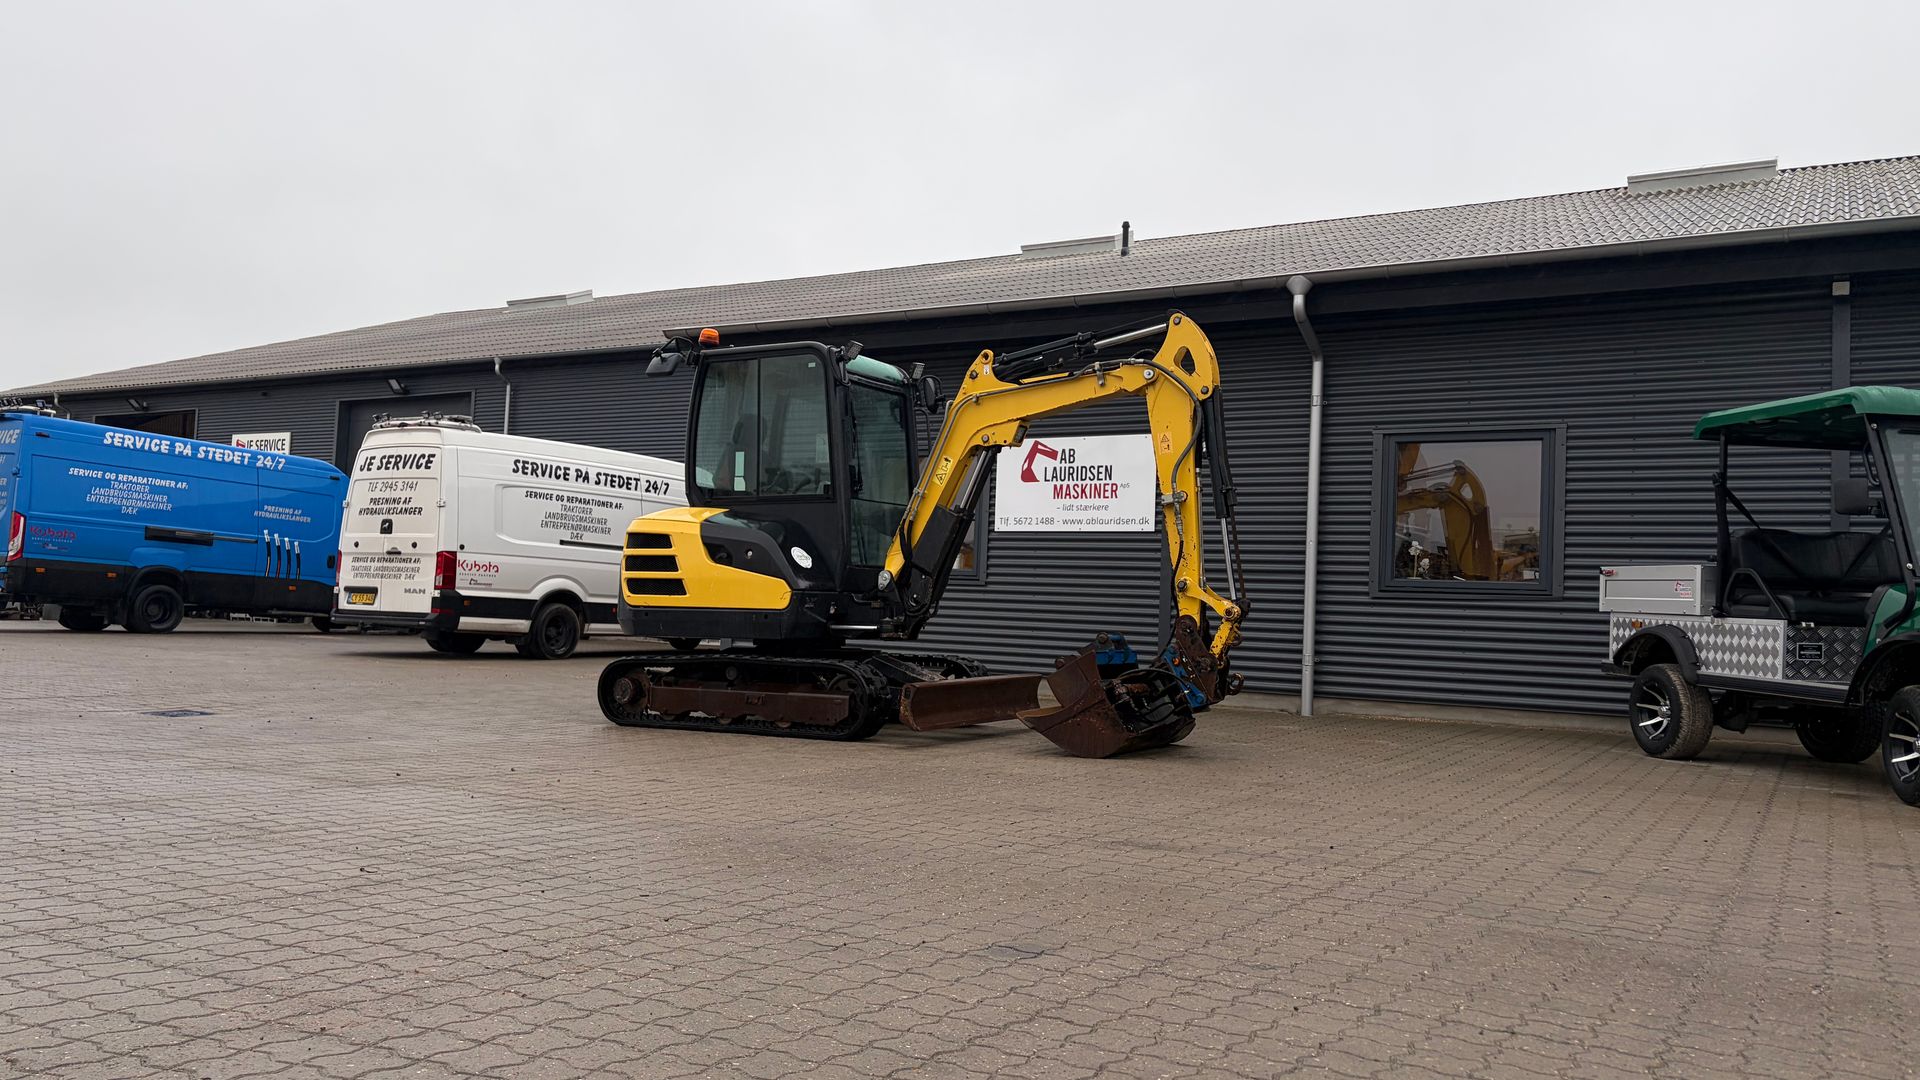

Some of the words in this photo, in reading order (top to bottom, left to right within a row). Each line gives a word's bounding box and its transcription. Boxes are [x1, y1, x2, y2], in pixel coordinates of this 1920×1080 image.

[103, 431, 170, 454] SERVICE
[174, 441, 191, 457] PÅ
[197, 446, 251, 465] STEDET
[256, 455, 286, 471] 24/7
[255, 438, 286, 452] SERVICE
[360, 455, 376, 472] JE
[377, 453, 436, 471] SERVICE
[1059, 448, 1076, 464] AB
[68, 467, 103, 479] SERVICE
[105, 472, 116, 480] OG
[118, 474, 176, 489] REPARATIONER
[512, 459, 570, 481] SERVICE
[574, 467, 590, 484] PÅ
[594, 472, 640, 491] STEDET
[644, 479, 670, 496] 24/7
[1043, 465, 1113, 482] LAURIDSEN
[110, 481, 150, 493] TRAKTORER
[368, 481, 379, 492] TLF
[379, 480, 399, 493] 2945
[400, 480, 419, 492] 3141
[1052, 483, 1119, 500] MASKINER
[91, 486, 168, 503] LANDBRUGSMASKINER
[368, 496, 401, 506] PRESNING
[402, 496, 412, 506] AF
[525, 490, 553, 502] SERVICE
[555, 494, 565, 502] OG
[566, 495, 614, 510] REPARATIONER
[86, 494, 172, 511] ENTREPRENØRMASKINER
[1062, 503, 1074, 512] lidt
[1075, 503, 1109, 512] stærkere
[121, 505, 139, 515] DÆK
[358, 506, 423, 517] HYDRAULIKSLANGER
[560, 504, 594, 516] TRAKTORER
[544, 511, 608, 526] LANDBRUGSMASKINER
[999, 517, 1012, 527] Tlf.
[1013, 516, 1033, 526] 5672
[1035, 516, 1055, 526] 1488
[1062, 516, 1150, 526] www.ablauridsen.dk
[540, 520, 612, 535] ENTREPRENØRMASKINER
[570, 531, 585, 541] DÆK
[458, 559, 499, 573] Kubota
[404, 587, 426, 595] MAN
